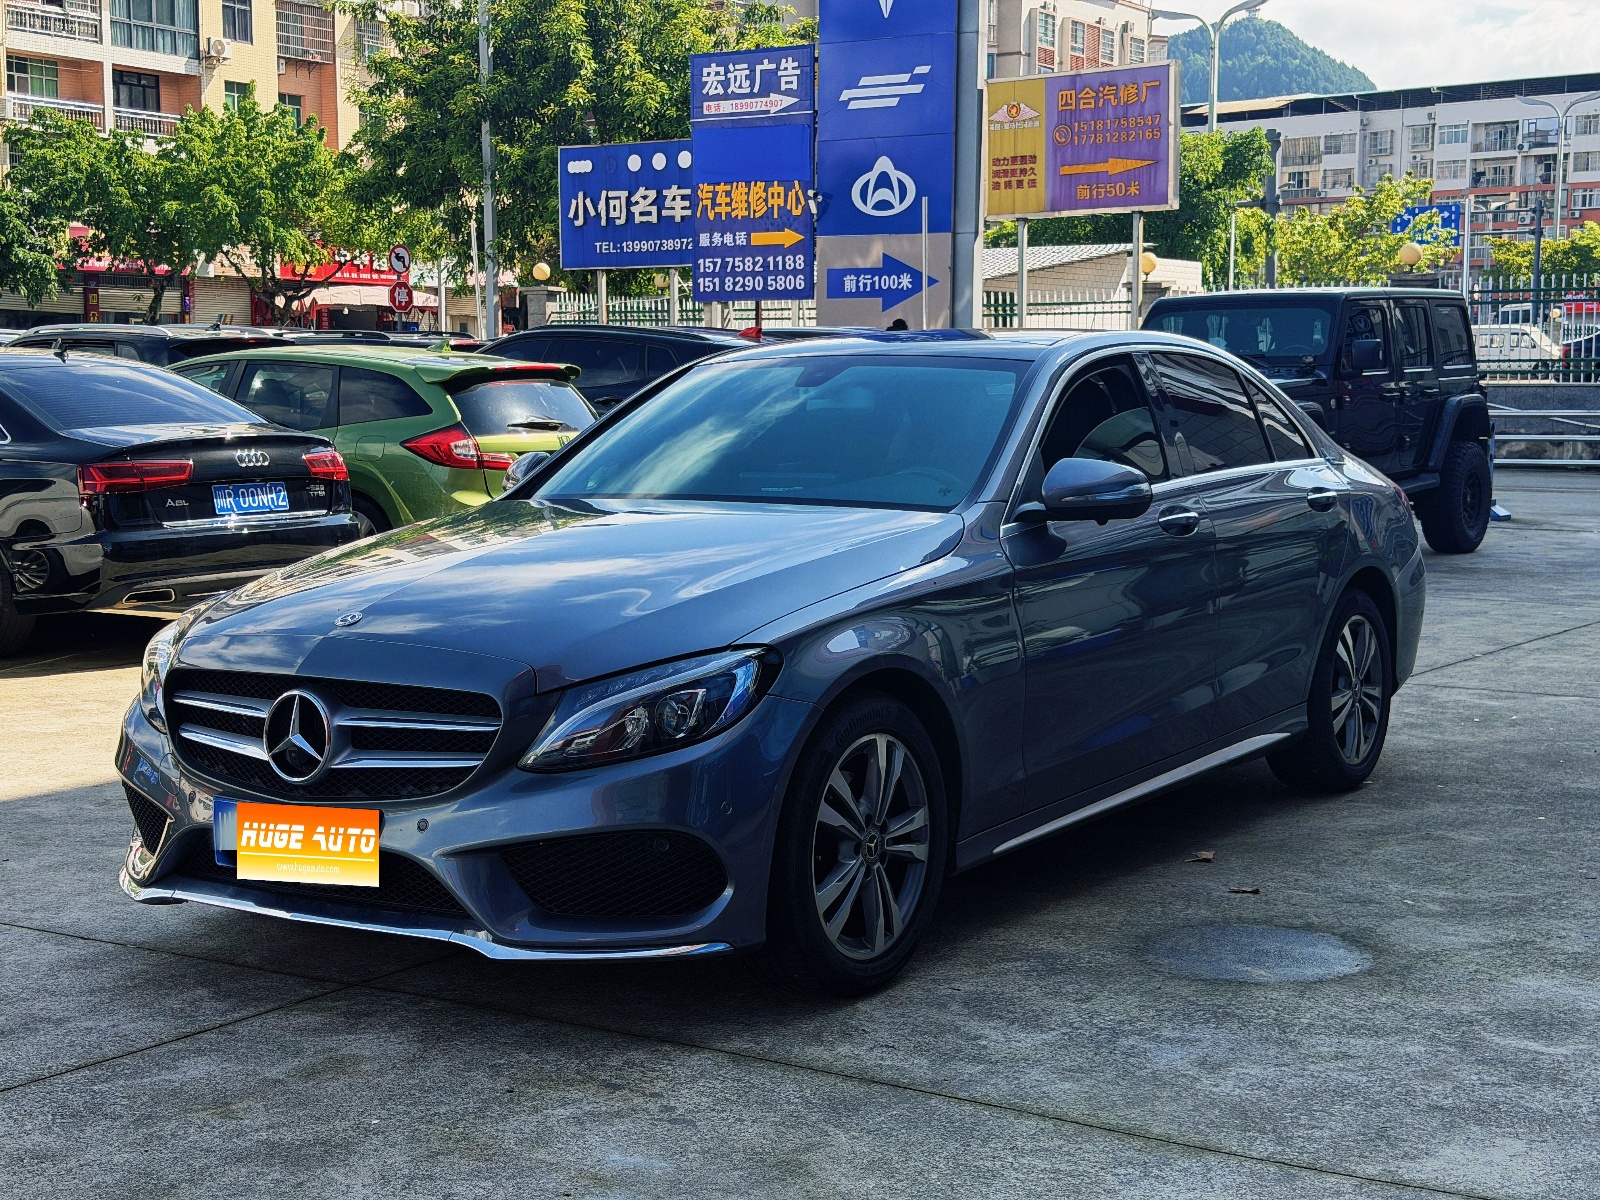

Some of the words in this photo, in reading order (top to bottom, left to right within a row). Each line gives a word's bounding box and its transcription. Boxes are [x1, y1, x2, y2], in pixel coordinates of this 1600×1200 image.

[702, 57, 801, 96] 宏远广告
[730, 99, 784, 111] 18990774907
[1058, 80, 1161, 111] 四合汽修厂
[1073, 114, 1162, 133] 15181758547
[1073, 127, 1162, 146] 17781282165
[567, 184, 692, 227] 小何名车
[696, 180, 806, 221] 汽车维修中心
[699, 231, 748, 247] 服务电话
[697, 258, 722, 273] 157
[725, 256, 764, 273] 7582
[766, 254, 805, 272] 1188
[697, 276, 720, 293] 151
[724, 275, 764, 292] 8290
[767, 274, 805, 291] 5806
[843, 272, 913, 293] 前行100米
[393, 286, 409, 306] 停
